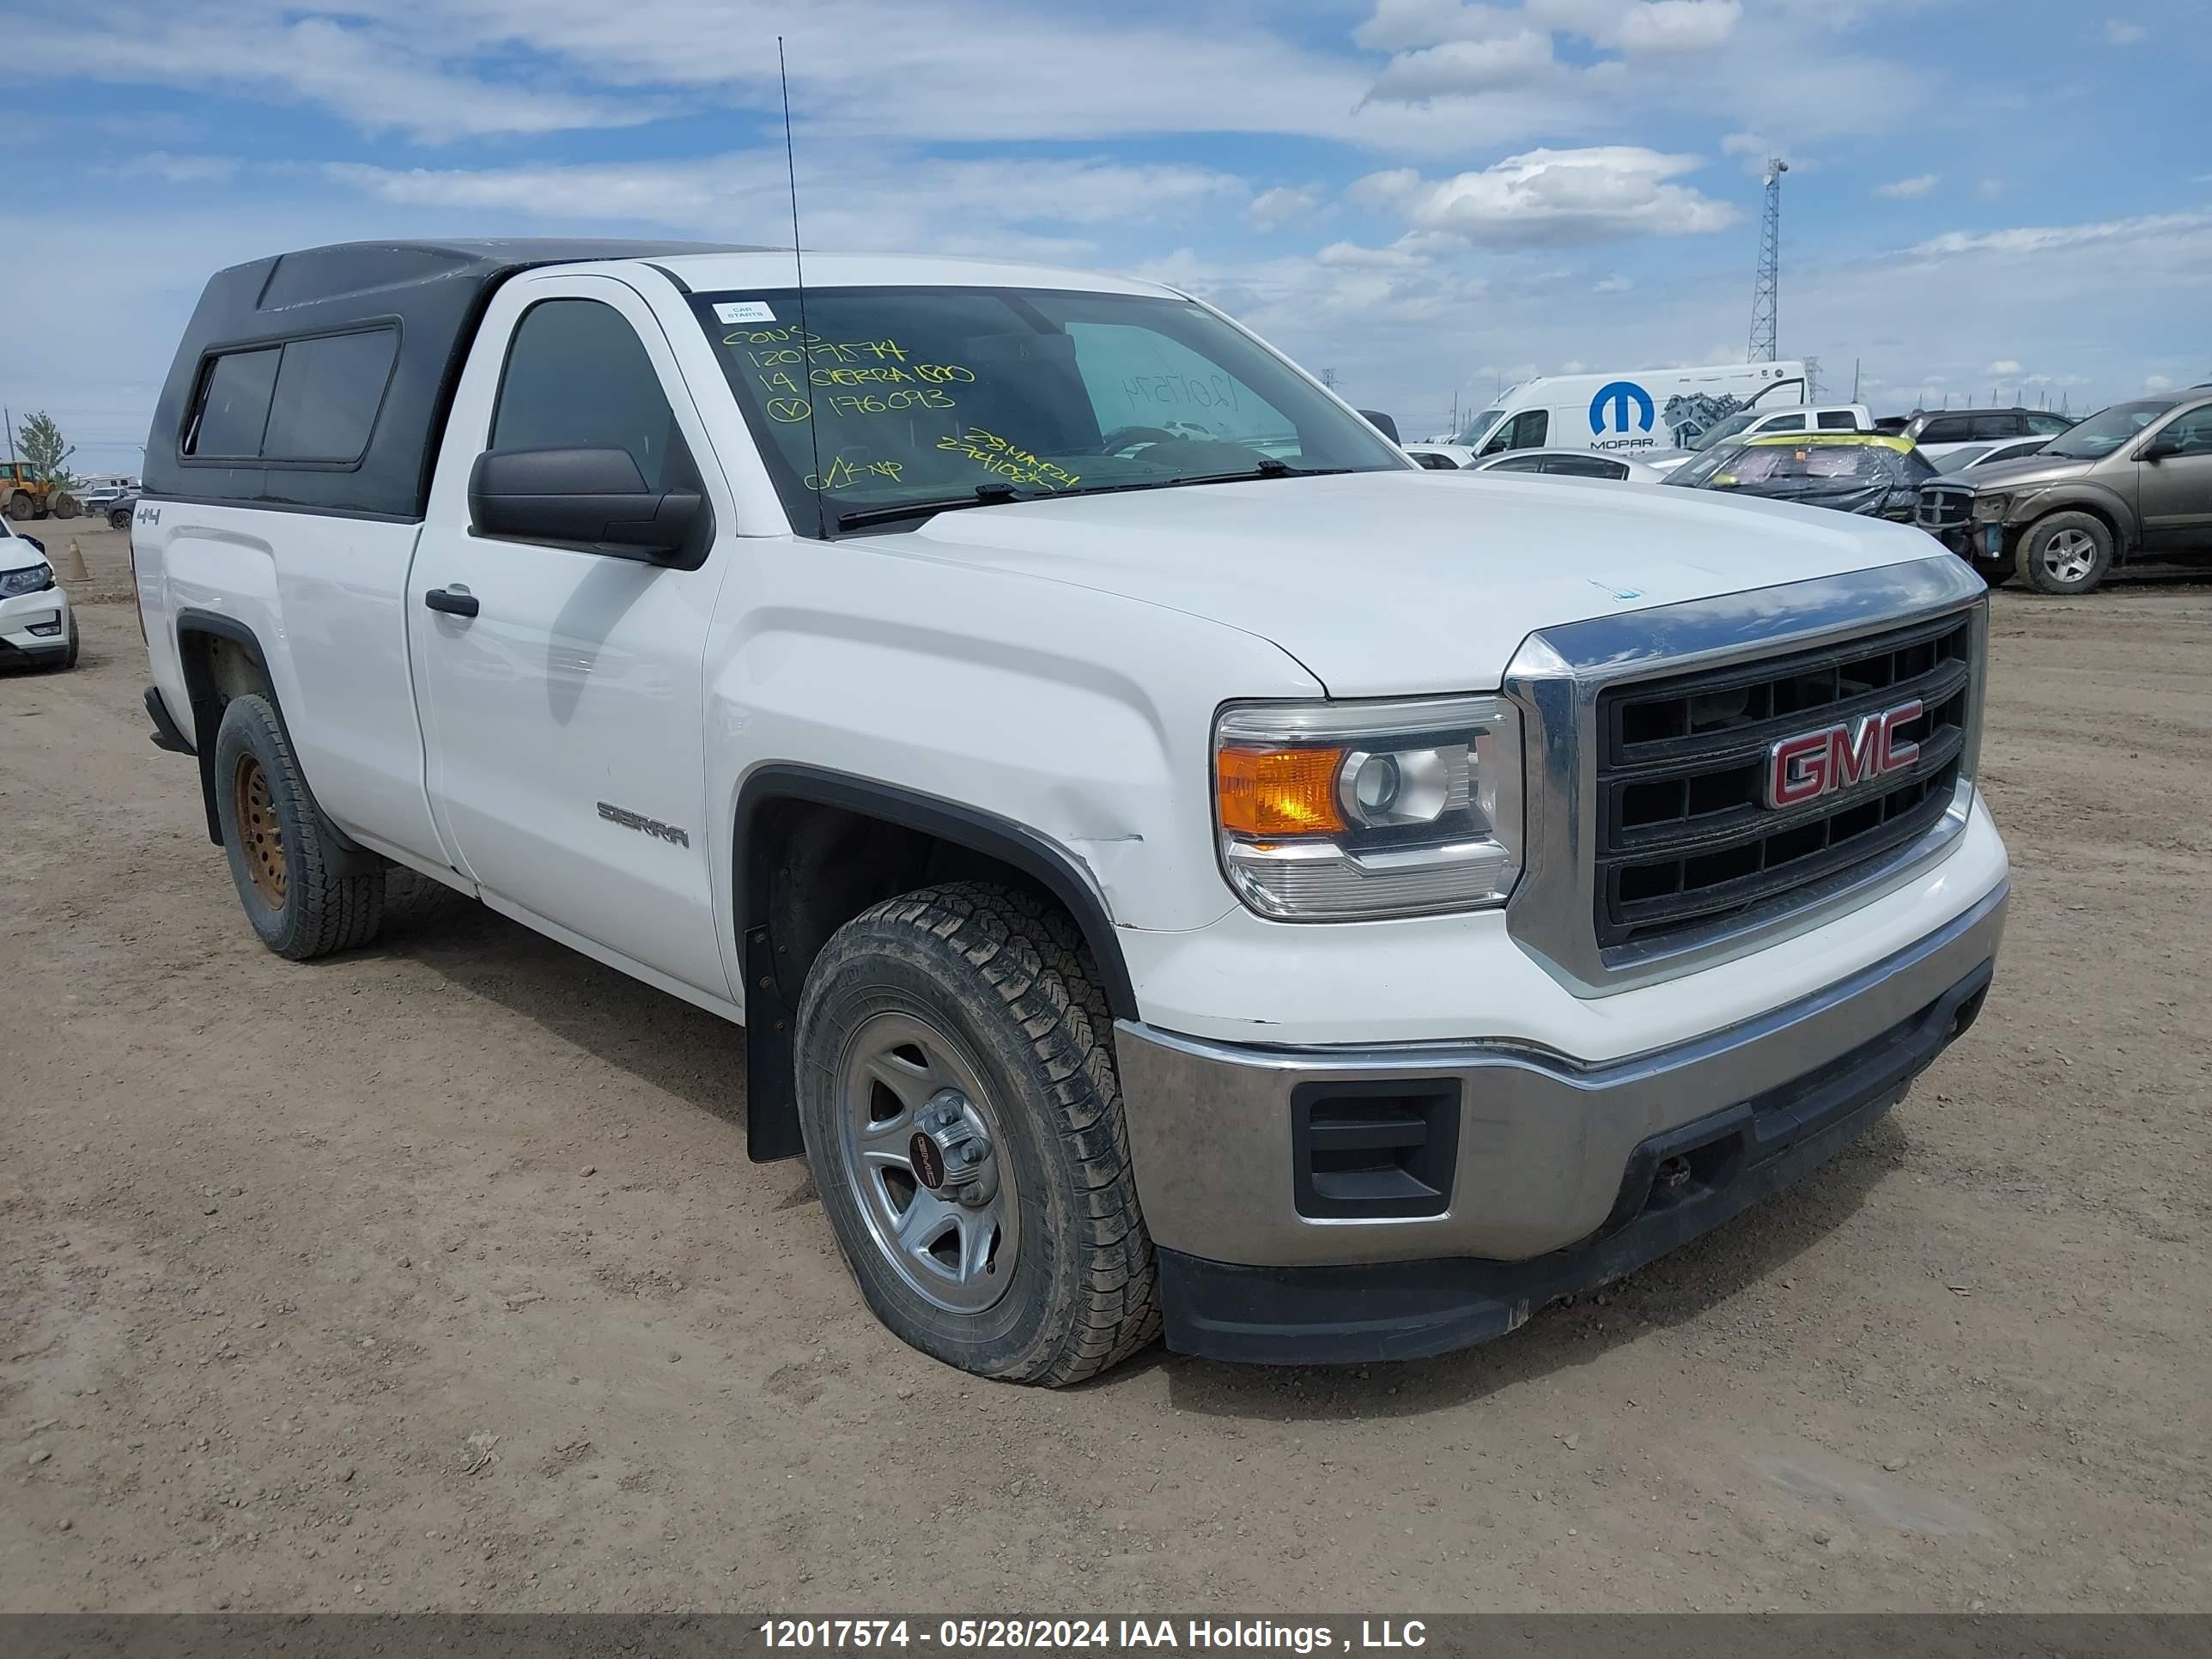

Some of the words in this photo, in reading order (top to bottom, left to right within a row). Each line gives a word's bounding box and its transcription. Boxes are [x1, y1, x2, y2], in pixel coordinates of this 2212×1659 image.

[748, 339, 909, 368] 12017574
[759, 372, 798, 392] 14
[828, 389, 956, 417] 176093
[1590, 438, 1654, 450] MOPAR
[1768, 698, 1924, 810] GMC
[596, 800, 690, 849] SIERRA
[917, 1136, 937, 1187] GMC
